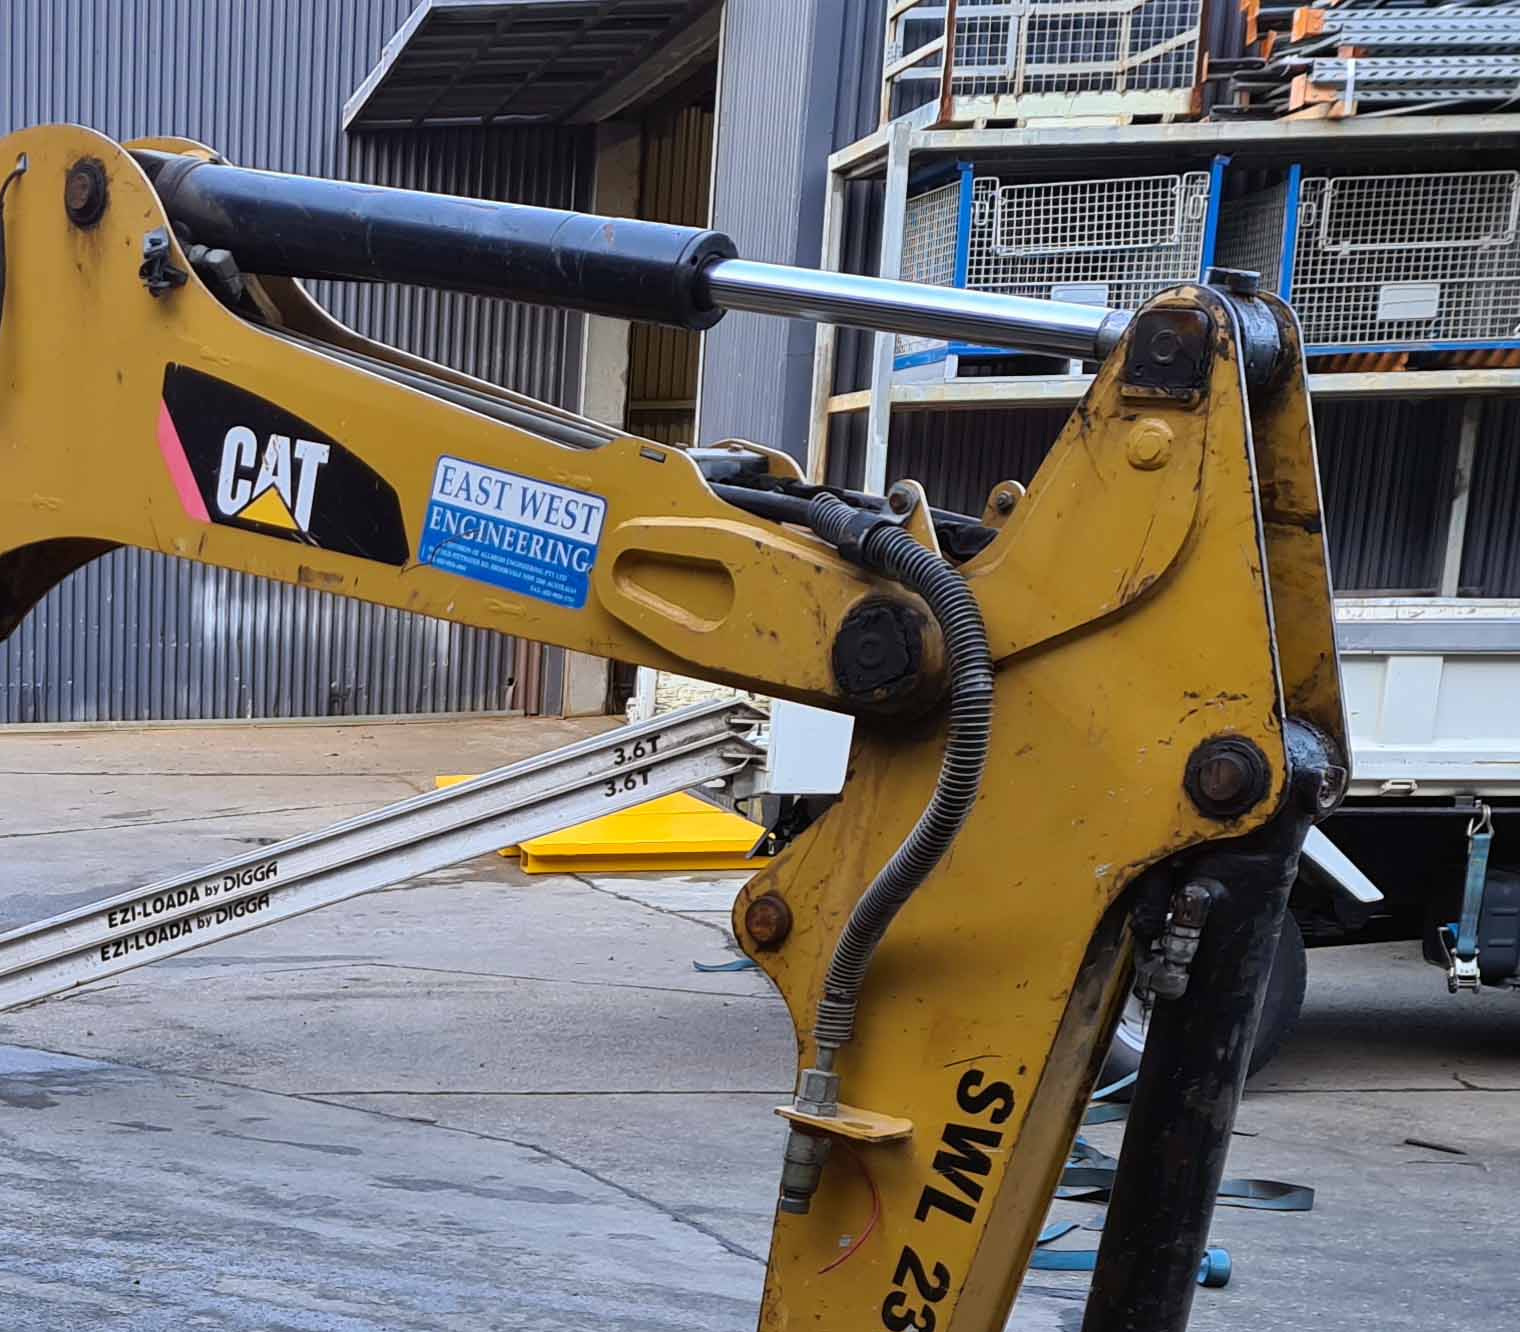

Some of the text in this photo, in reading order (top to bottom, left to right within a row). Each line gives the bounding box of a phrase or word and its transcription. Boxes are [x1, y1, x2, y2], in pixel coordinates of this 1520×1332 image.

[217, 425, 330, 533] CAT
[439, 465, 600, 535] EAST WEST
[430, 506, 591, 573] ENGINEERING
[605, 767, 653, 797] 3.6T
[614, 735, 661, 765] 3.6T
[100, 893, 270, 962] EZI-LOADA by DIGGA
[108, 861, 278, 928] EZI-LOADA by DIGGA
[914, 1069, 1015, 1224] SWL
